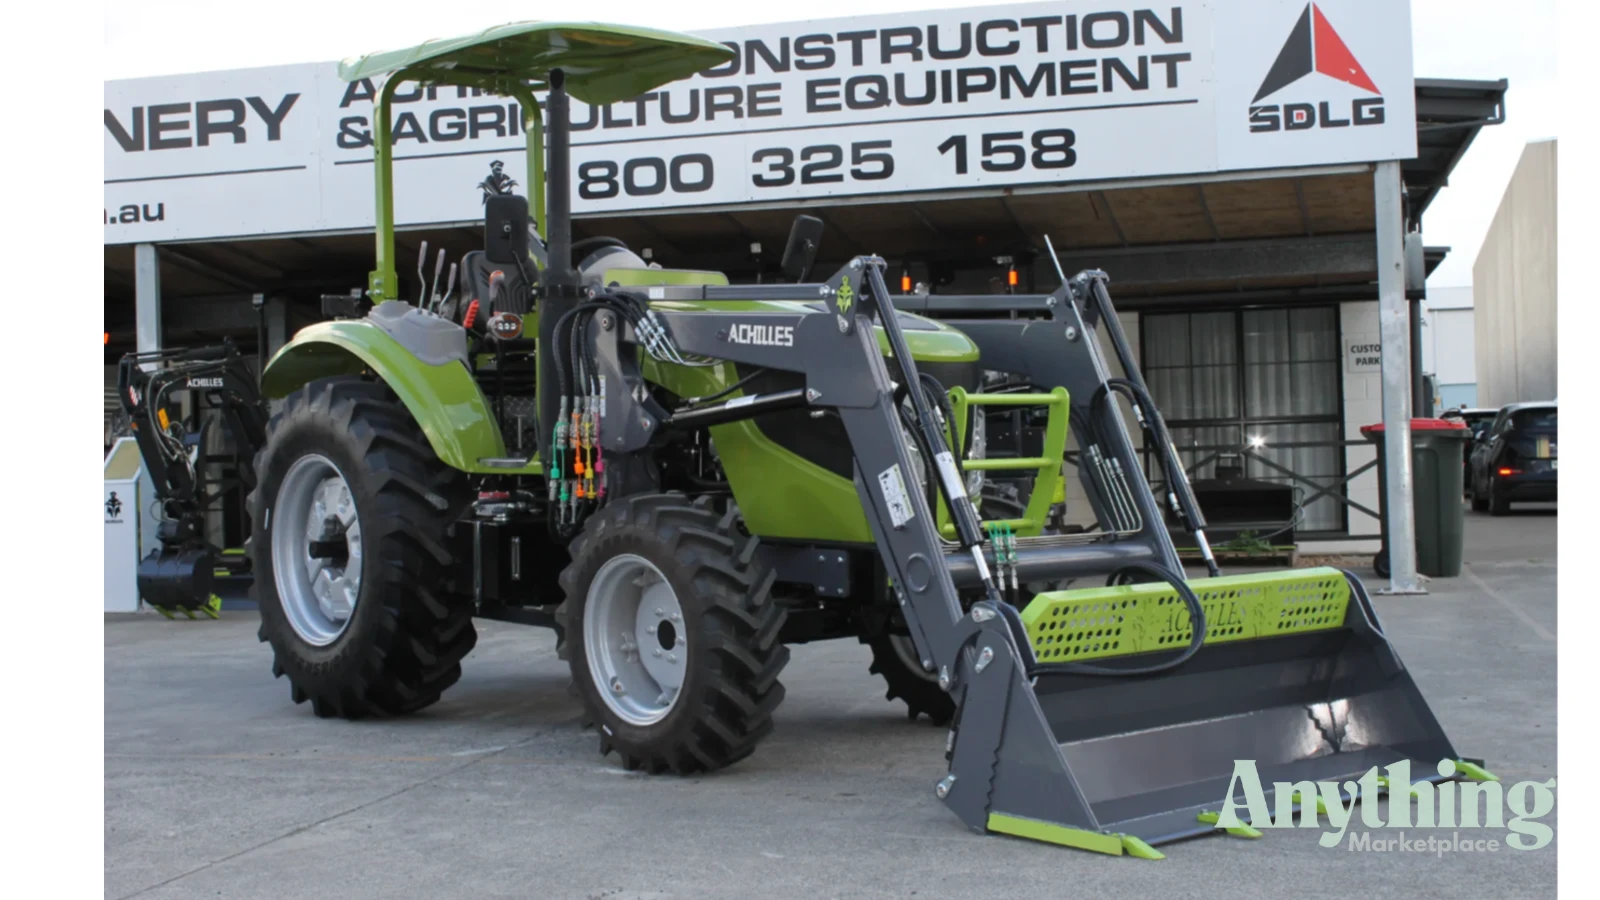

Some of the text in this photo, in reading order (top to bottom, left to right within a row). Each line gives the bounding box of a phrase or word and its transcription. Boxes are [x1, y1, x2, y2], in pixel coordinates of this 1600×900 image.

[699, 6, 1183, 78] ONSTRUCTION
[337, 115, 376, 149] &
[391, 82, 783, 146] AGRIULTURE
[806, 53, 1192, 113] EQUIPMENT
[1249, 97, 1386, 133] SDLG
[544, 128, 1077, 200] 800 325 158
[104, 202, 165, 225] .au
[728, 323, 794, 347] ACHILLES
[187, 377, 224, 389] ACHILLES
